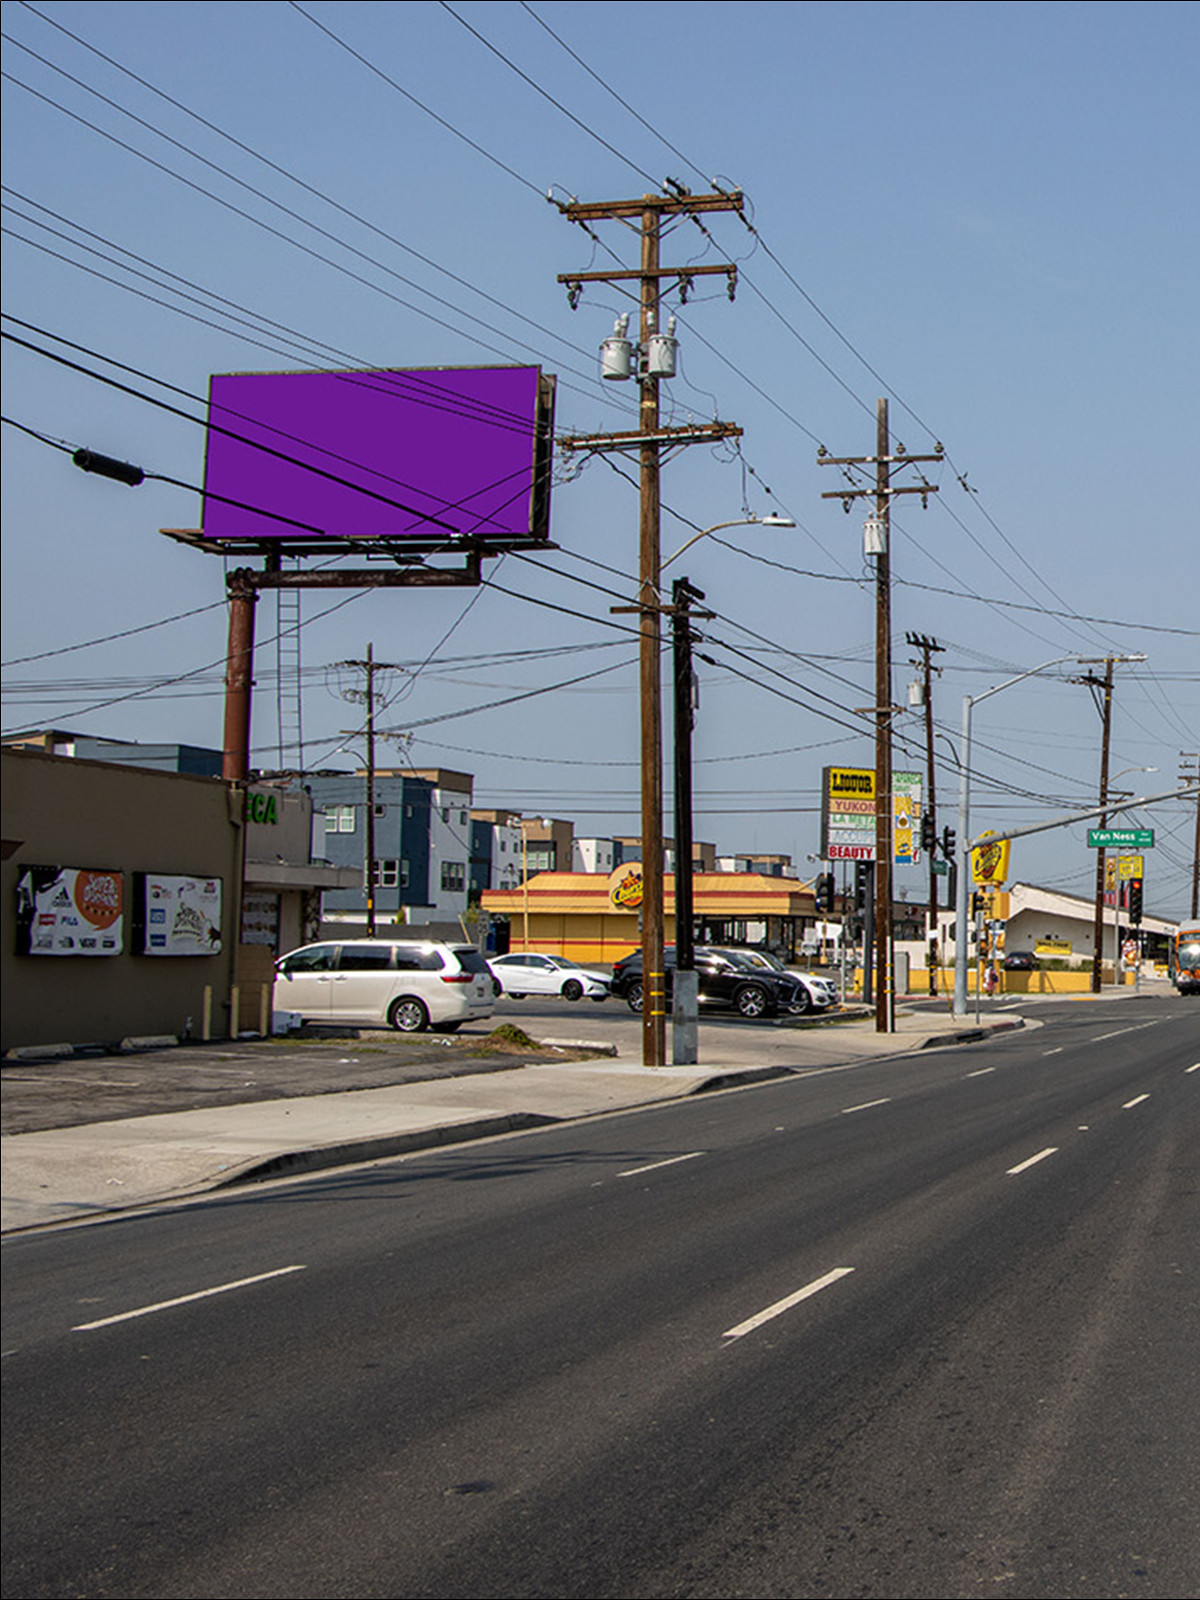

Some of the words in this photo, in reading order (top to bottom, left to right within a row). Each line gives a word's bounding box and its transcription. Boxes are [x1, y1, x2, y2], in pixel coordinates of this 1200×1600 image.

[832, 774, 872, 793] LIQUOR
[1092, 832, 1111, 841] Van
[1113, 832, 1136, 841] Ness
[828, 846, 873, 859] BEAUTY
